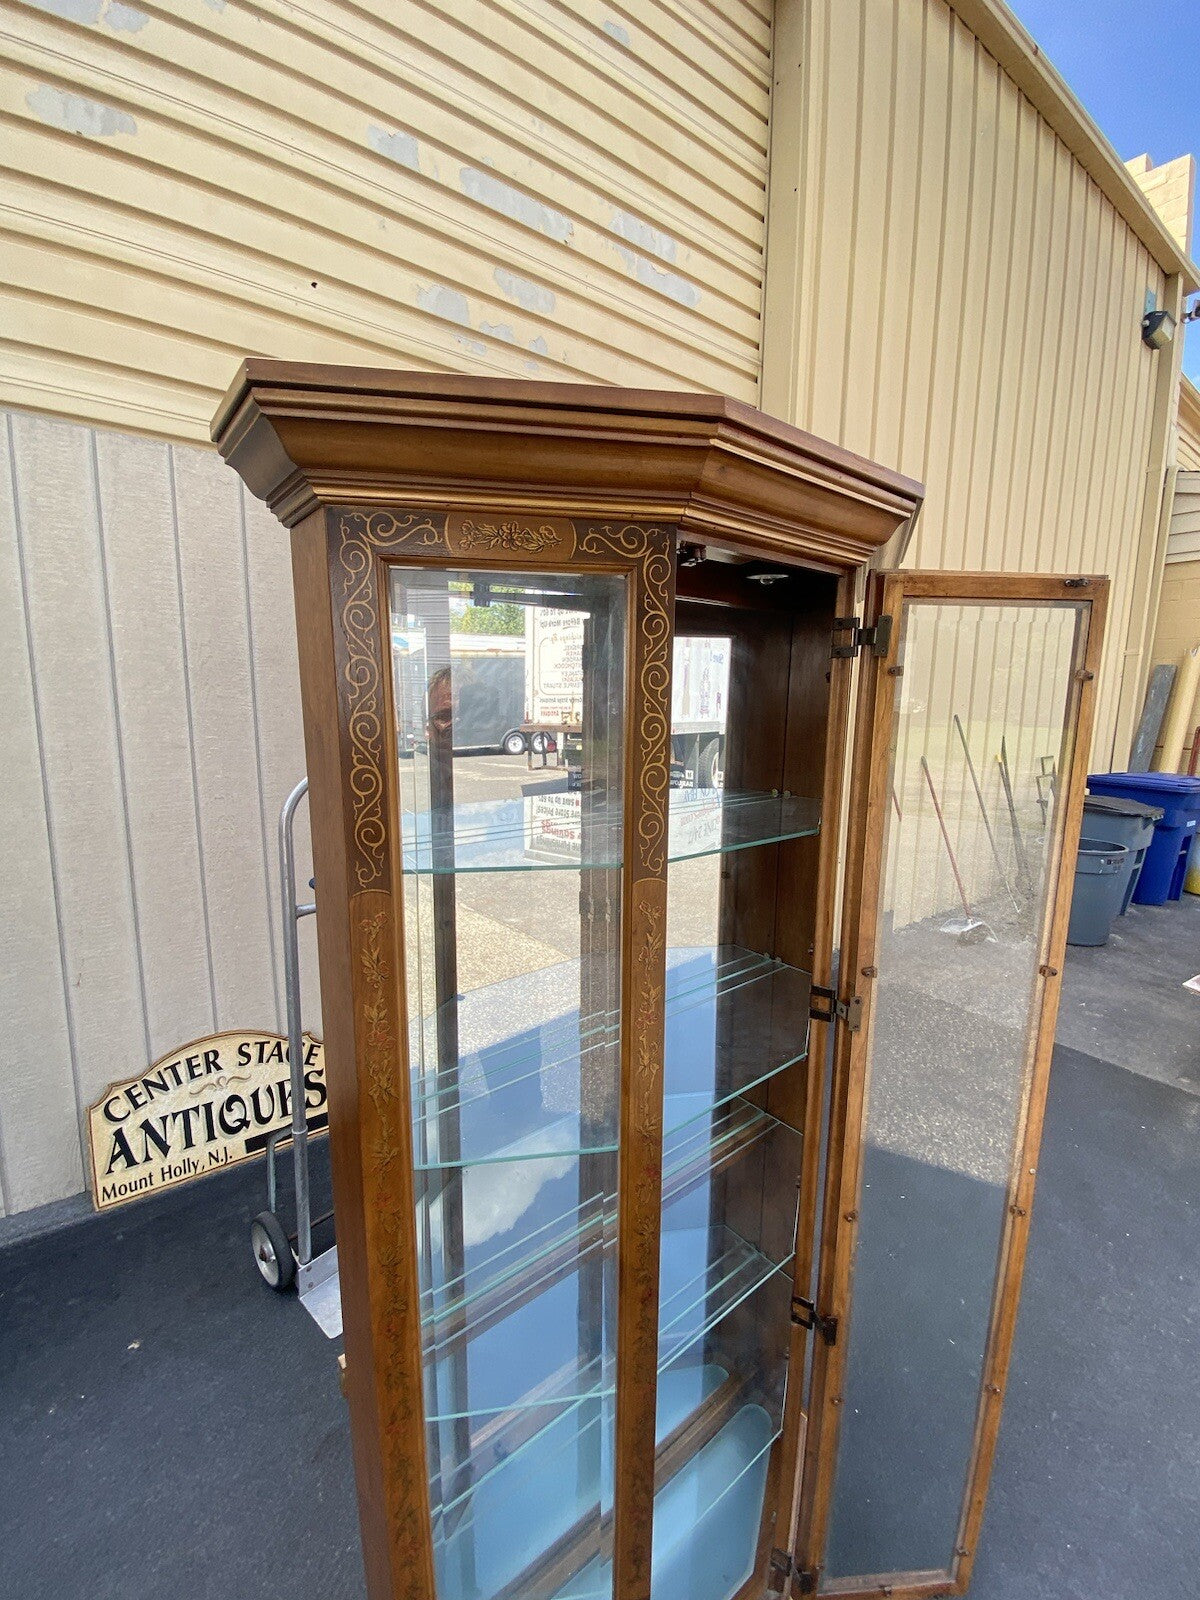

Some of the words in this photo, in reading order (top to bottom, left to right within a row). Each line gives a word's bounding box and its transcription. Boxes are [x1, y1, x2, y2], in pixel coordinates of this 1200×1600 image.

[103, 1049, 224, 1123] CENTER
[102, 1172, 154, 1202] Mount
[161, 1157, 205, 1182] Holly,
[208, 1146, 233, 1167] N.J.
